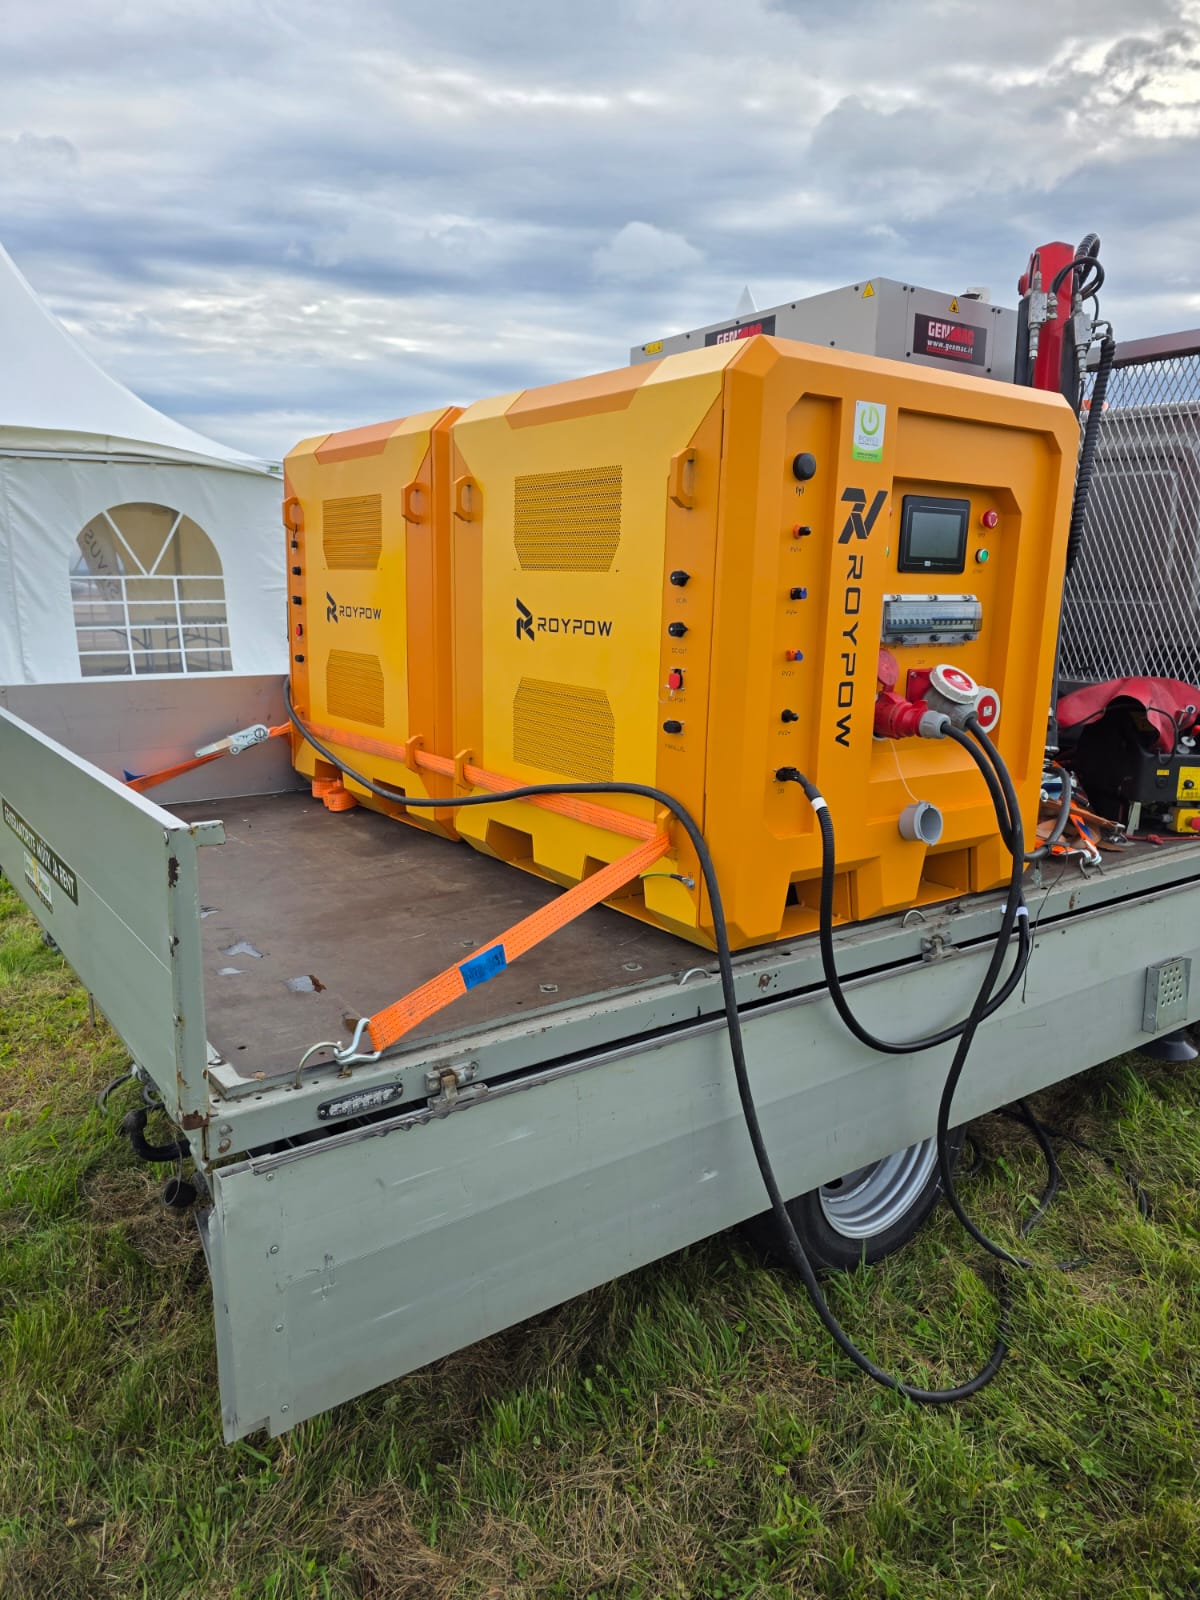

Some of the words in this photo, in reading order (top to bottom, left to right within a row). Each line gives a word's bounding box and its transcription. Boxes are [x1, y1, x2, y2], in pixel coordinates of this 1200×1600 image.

[339, 605, 382, 620] ROYPOW
[537, 617, 613, 637] ROYPOW
[835, 555, 864, 747] ROYPOW
